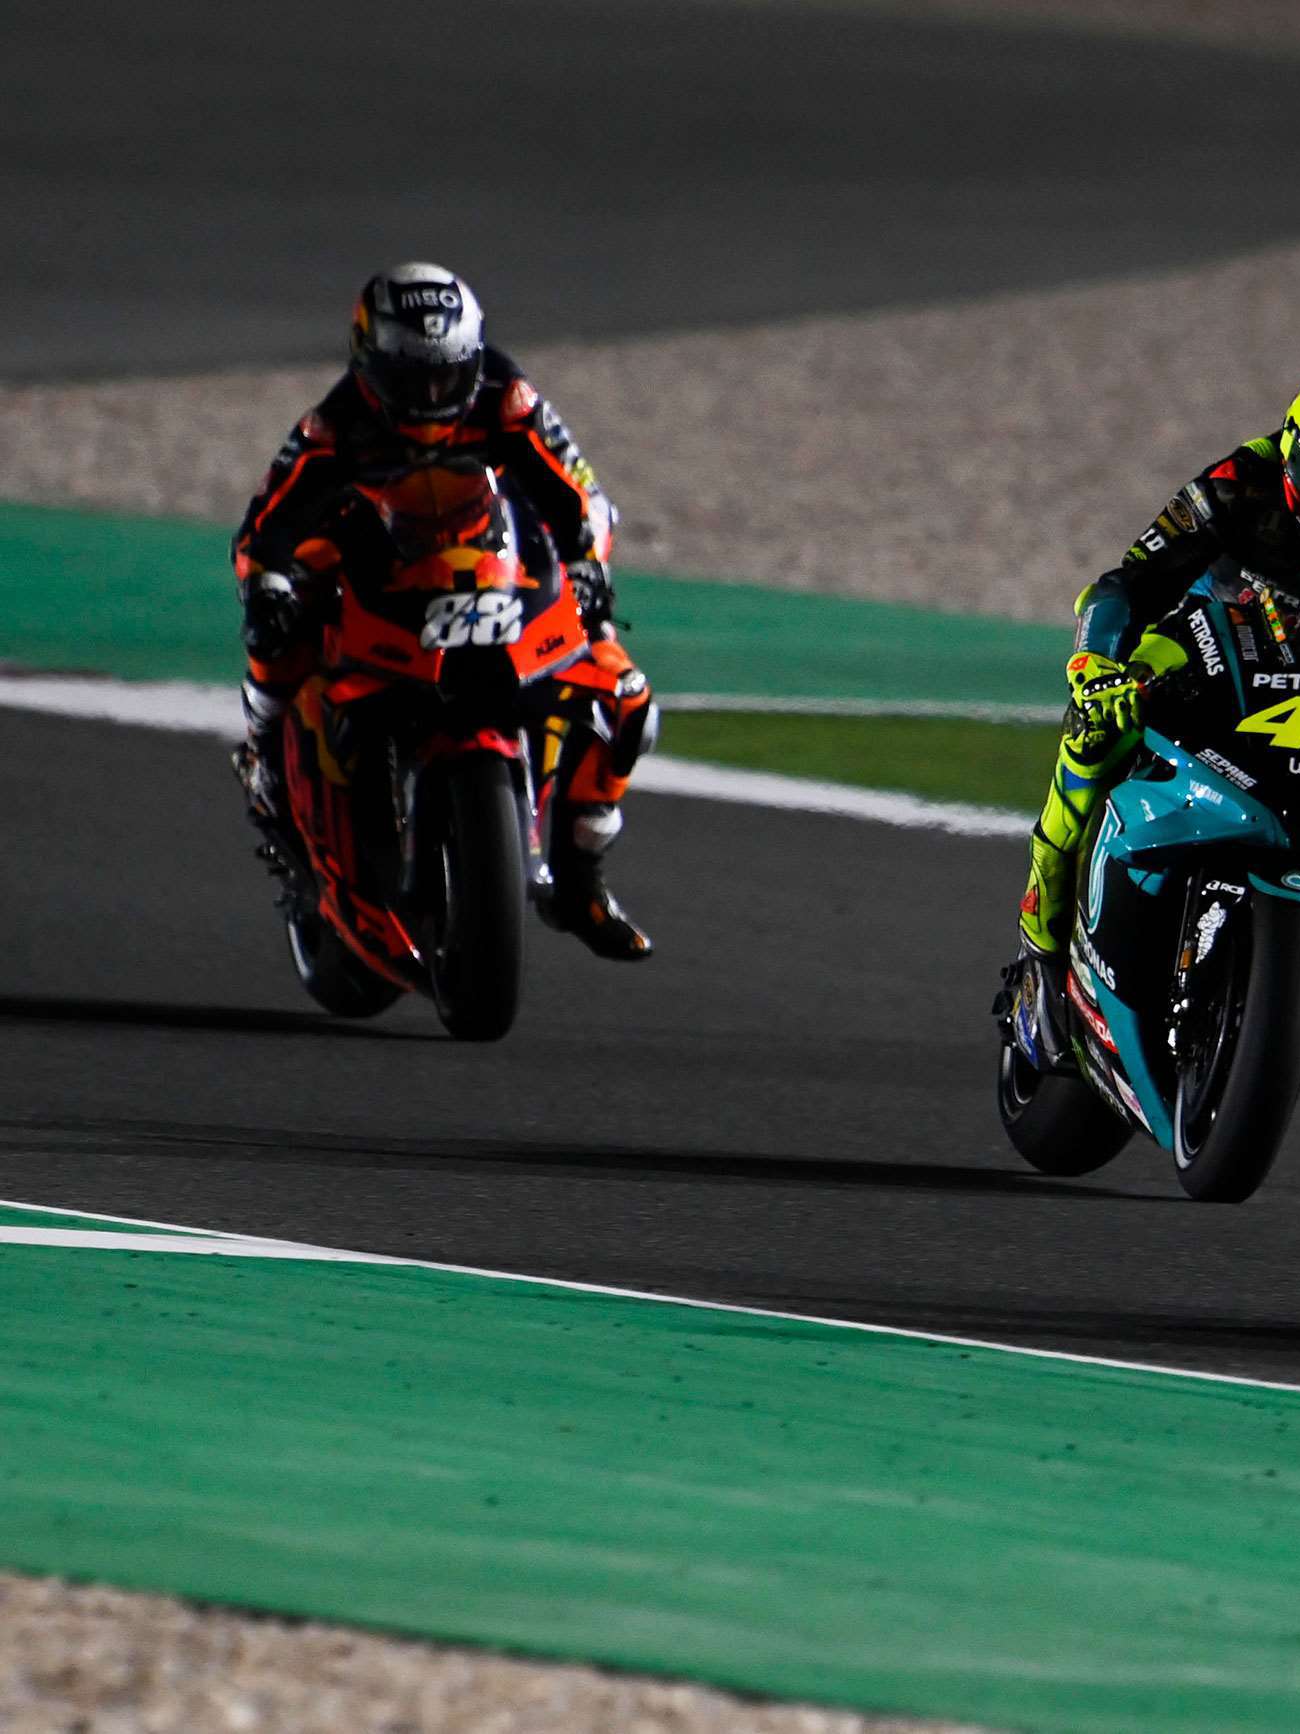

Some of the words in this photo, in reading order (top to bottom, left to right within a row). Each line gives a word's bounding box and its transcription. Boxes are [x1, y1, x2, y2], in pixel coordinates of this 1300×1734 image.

[420, 592, 523, 648] 88
[1187, 608, 1225, 677] PETRONAS
[1199, 748, 1258, 788] SEPANG
